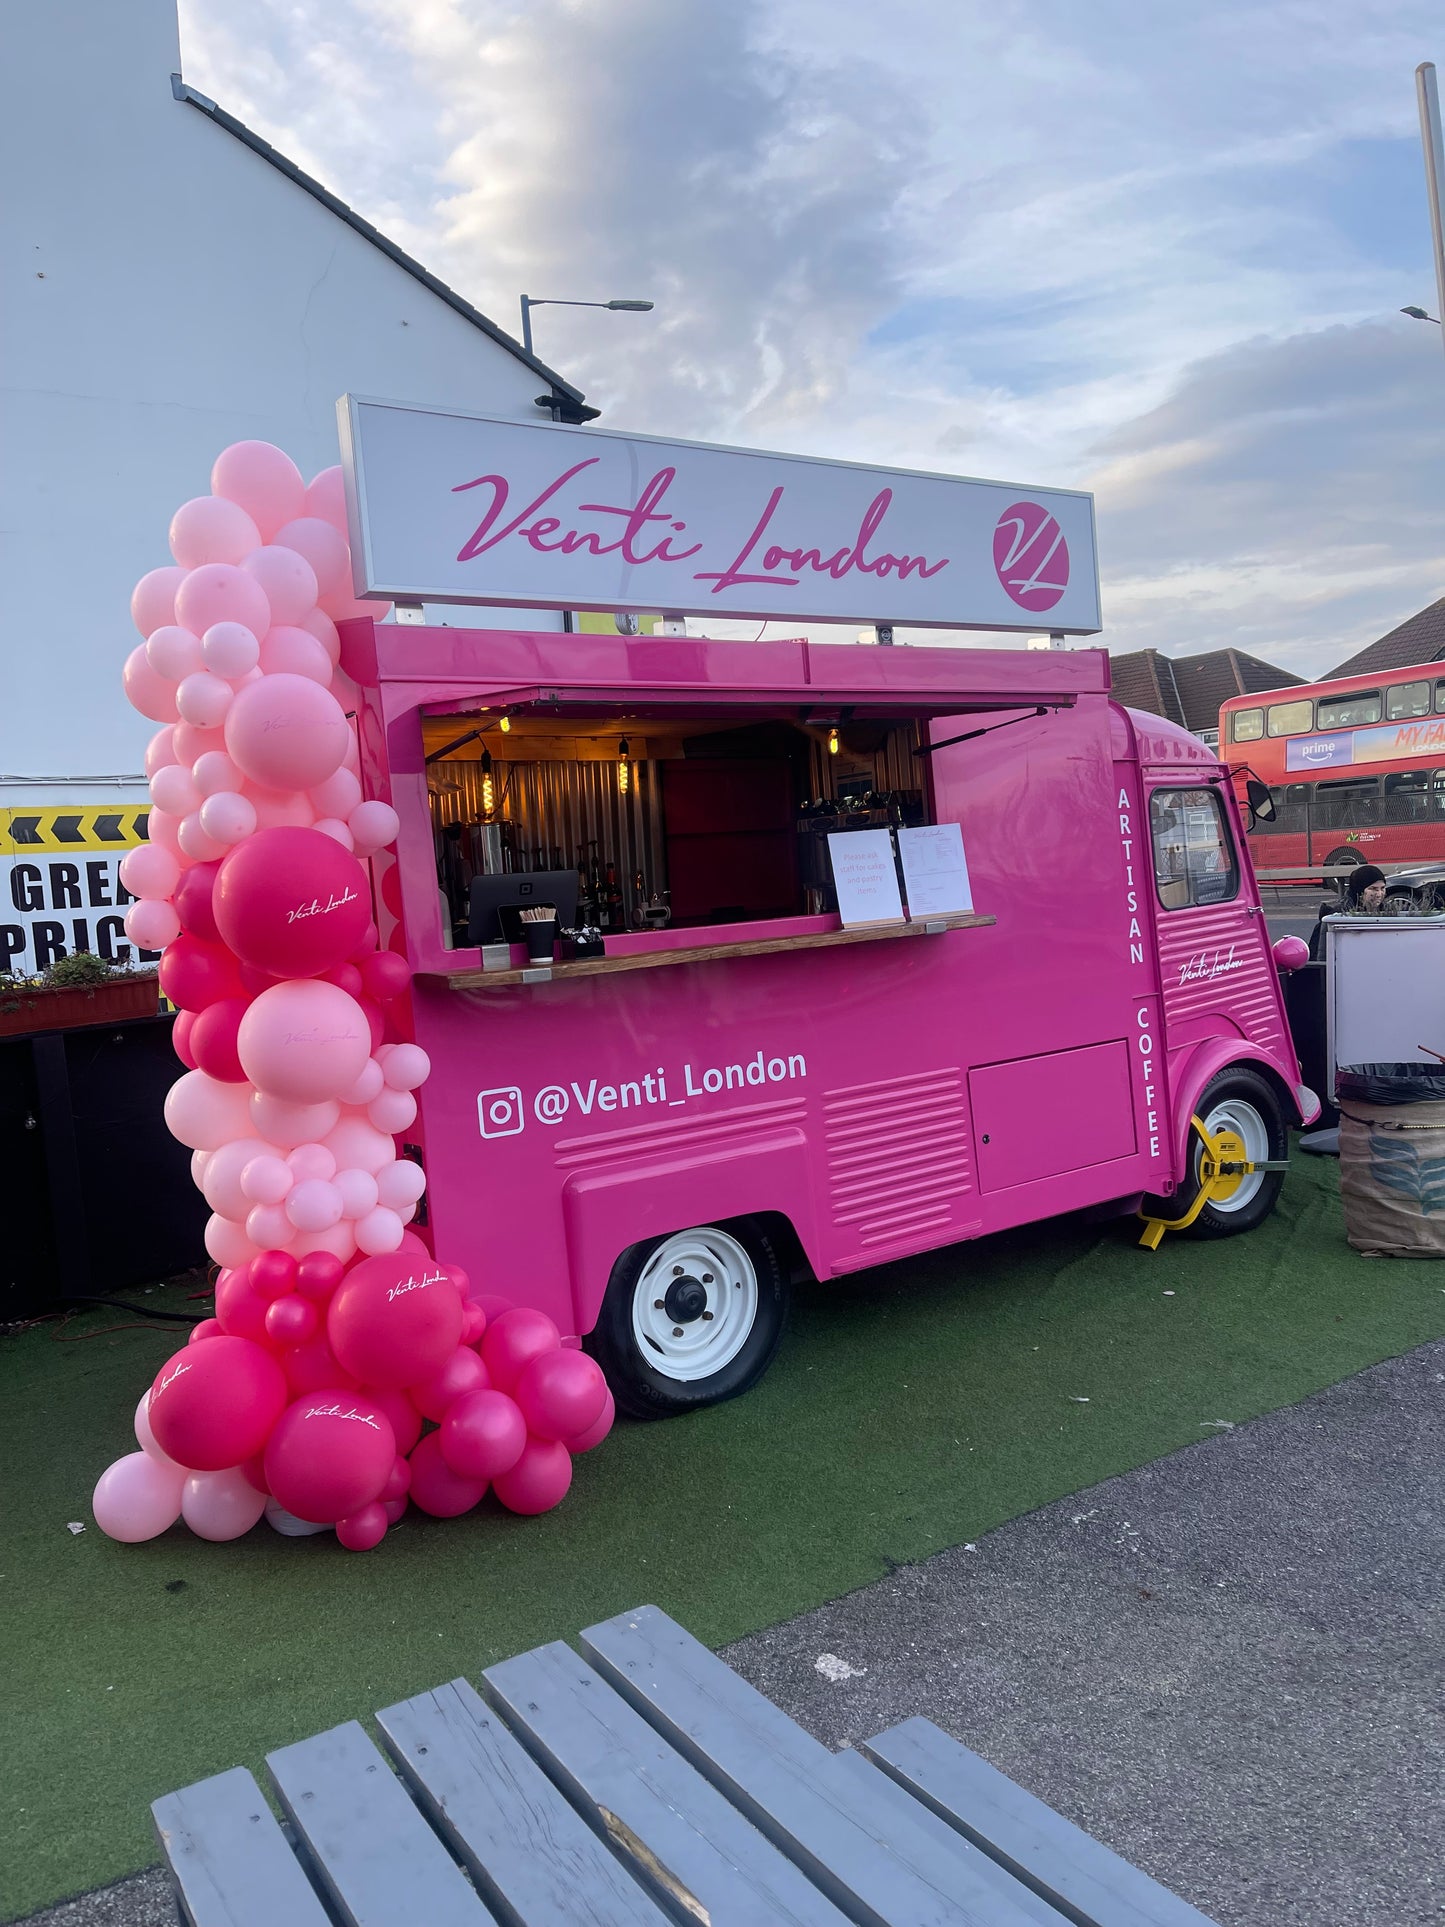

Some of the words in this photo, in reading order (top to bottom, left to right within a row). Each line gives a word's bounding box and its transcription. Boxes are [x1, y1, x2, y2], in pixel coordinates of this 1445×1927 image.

[451, 457, 702, 565] Venti
[693, 486, 950, 594] London
[1302, 742, 1336, 757] prime
[1394, 726, 1424, 748] MY
[1118, 788, 1144, 964] ARTISAN
[286, 899, 323, 923] Venti
[322, 886, 358, 914] London
[1177, 952, 1210, 986] Venti
[1207, 944, 1244, 980] London
[533, 1050, 807, 1125] @Venti_London
[1137, 1007, 1160, 1158] COFFEE
[385, 1276, 420, 1302] Venti
[418, 1269, 449, 1289] London
[304, 1404, 342, 1419] Venti
[339, 1408, 381, 1430] London
